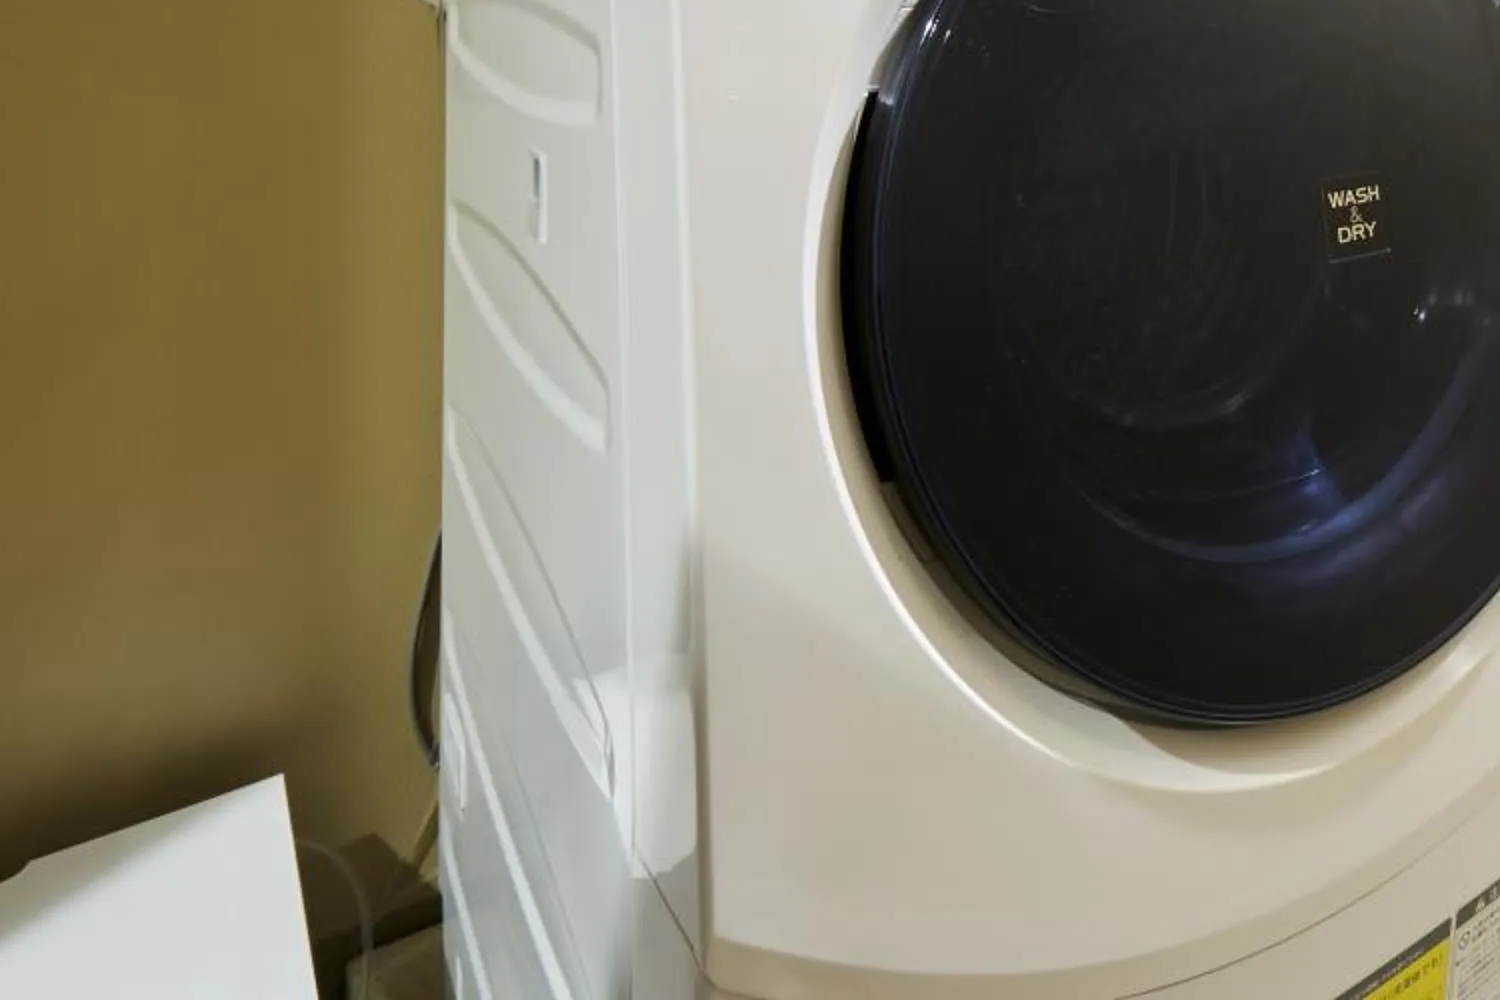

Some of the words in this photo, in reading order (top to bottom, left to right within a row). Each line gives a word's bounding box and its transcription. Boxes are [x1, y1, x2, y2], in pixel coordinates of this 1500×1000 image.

[1328, 184, 1380, 208] WASH
[1350, 206, 1362, 223] &
[1337, 221, 1376, 243] DRY
